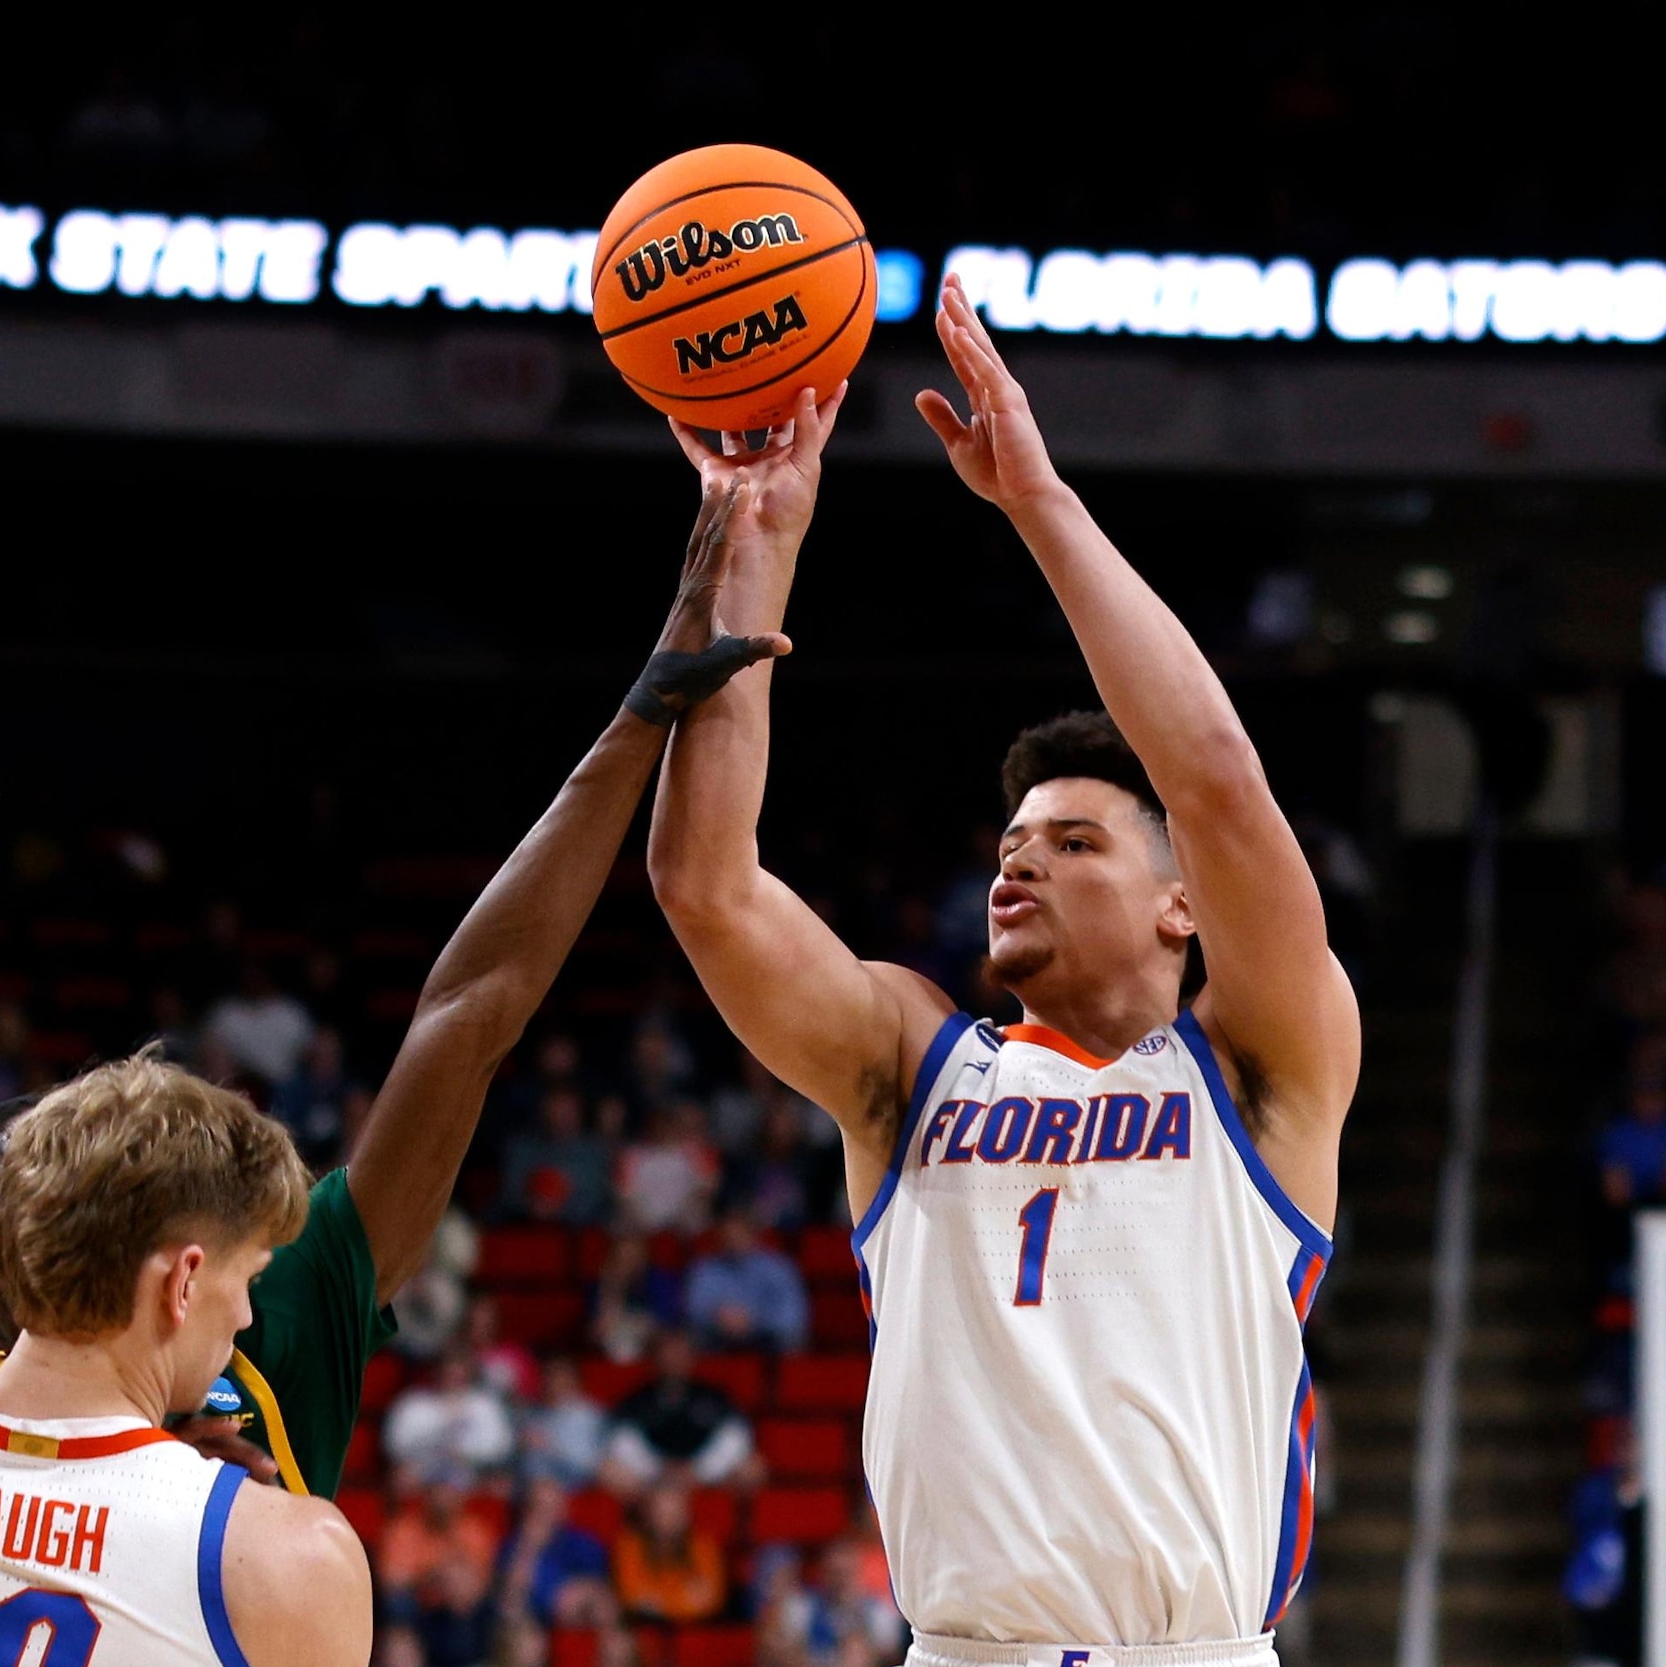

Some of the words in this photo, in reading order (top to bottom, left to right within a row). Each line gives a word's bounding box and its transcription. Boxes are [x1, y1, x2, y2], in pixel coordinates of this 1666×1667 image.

[49, 211, 327, 303] STATE
[615, 213, 804, 301] Wilson
[939, 246, 1318, 338] FLORIDA
[673, 294, 808, 375] NCAA
[921, 1091, 1190, 1167] FLORIDA
[1013, 1187, 1060, 1307] 1
